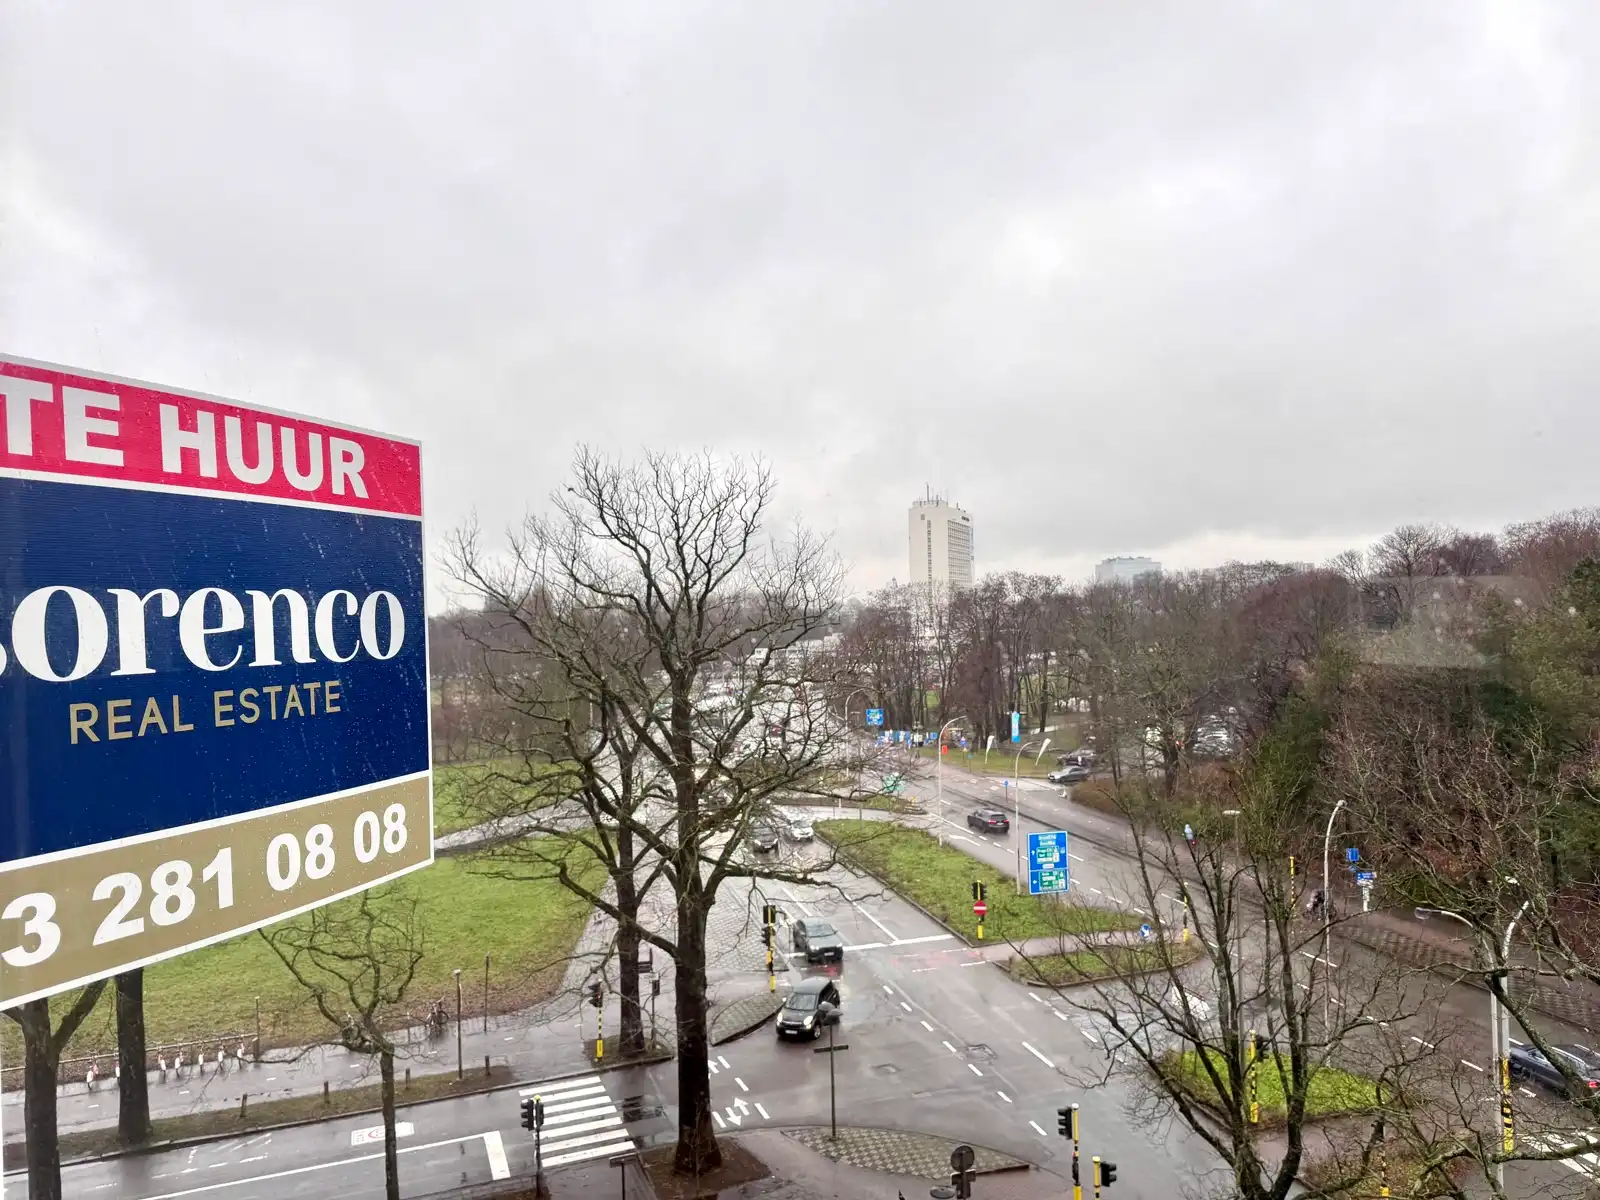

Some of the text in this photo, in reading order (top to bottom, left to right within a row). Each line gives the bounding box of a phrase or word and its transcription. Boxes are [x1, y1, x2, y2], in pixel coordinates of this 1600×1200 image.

[0, 375, 369, 499] TE HUUR
[0, 585, 405, 682] orenco
[69, 680, 342, 744] REAL ESTATE
[1, 803, 408, 967] 3 281 08 08
